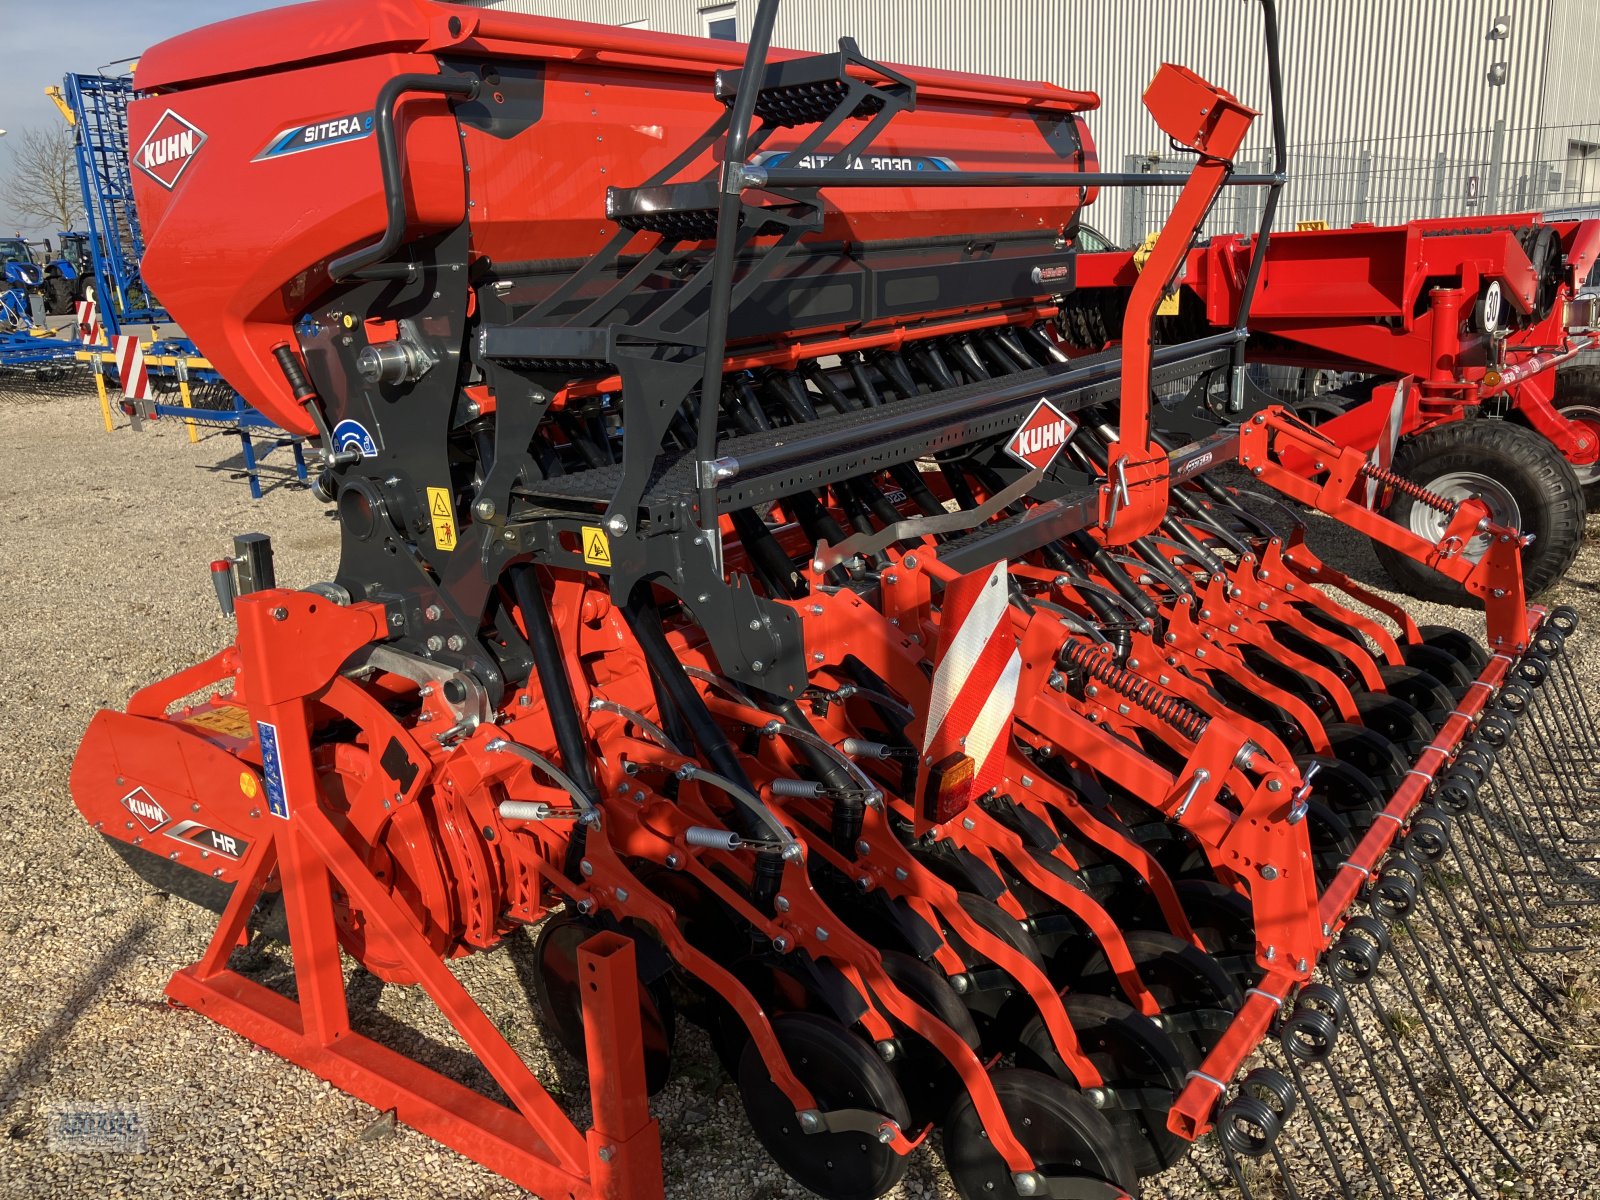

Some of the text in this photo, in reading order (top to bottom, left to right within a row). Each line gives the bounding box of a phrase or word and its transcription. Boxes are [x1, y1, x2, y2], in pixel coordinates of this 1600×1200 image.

[304, 116, 373, 143] SITERA e
[144, 129, 193, 169] KUHN
[1486, 290, 1499, 323] 30
[1019, 419, 1065, 457] KUHN
[128, 797, 164, 823] KUHN
[211, 830, 239, 857] HR
